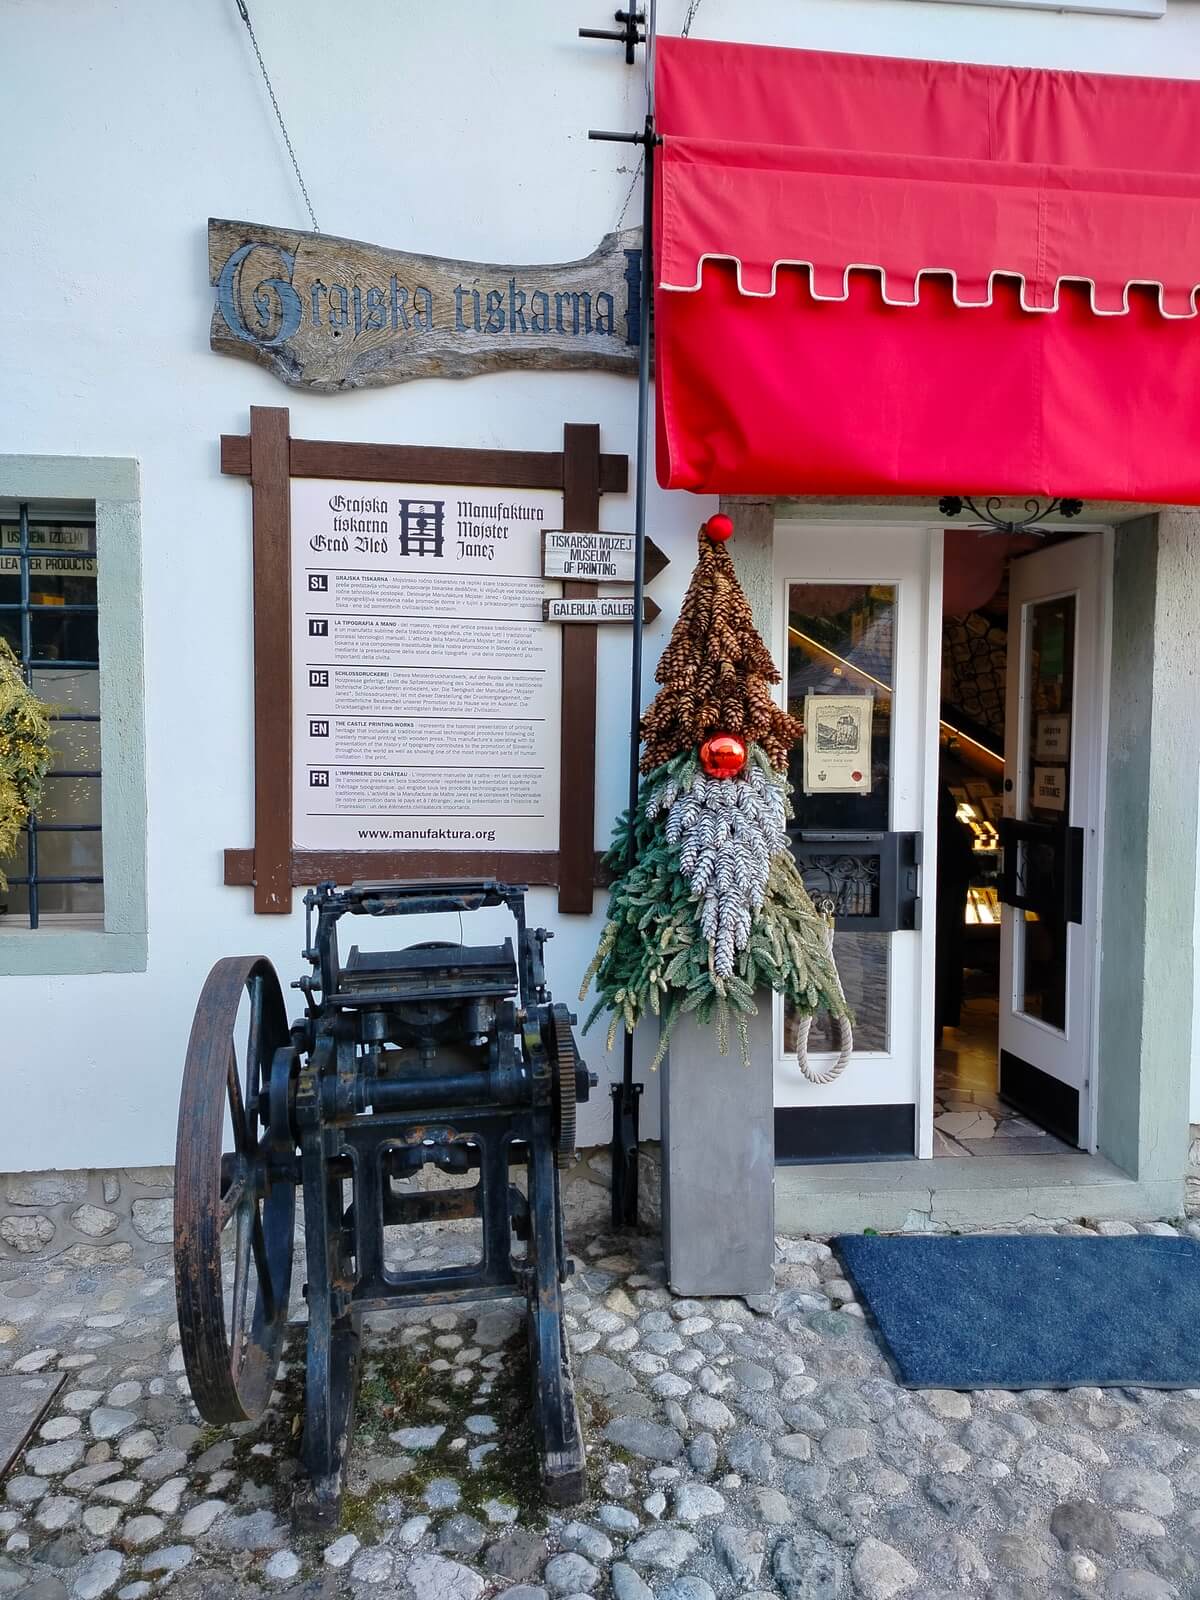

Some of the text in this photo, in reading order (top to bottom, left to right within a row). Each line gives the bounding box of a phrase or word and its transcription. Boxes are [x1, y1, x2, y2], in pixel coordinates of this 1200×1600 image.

[216, 241, 434, 346] Grajska
[453, 277, 616, 336] tiskarna
[328, 494, 388, 514] Grajska
[456, 502, 544, 521] Manufaktura
[334, 516, 388, 533] tiskarna
[456, 521, 508, 540] Mojster
[310, 534, 388, 554] Grad Bled
[456, 540, 494, 560] Janez
[600, 537, 632, 550] MUZEJ
[570, 549, 611, 562] MUSEUM
[0, 558, 93, 570] LEAER PRODUCTS
[564, 561, 616, 576] OF PRINTING
[310, 577, 326, 589] SL
[554, 604, 634, 616] GALERIJA GALLER
[313, 622, 324, 634] IT
[312, 672, 327, 684] DE
[312, 723, 327, 734] EN
[312, 774, 327, 784] FR
[358, 828, 496, 841] www.manufaktura.org
